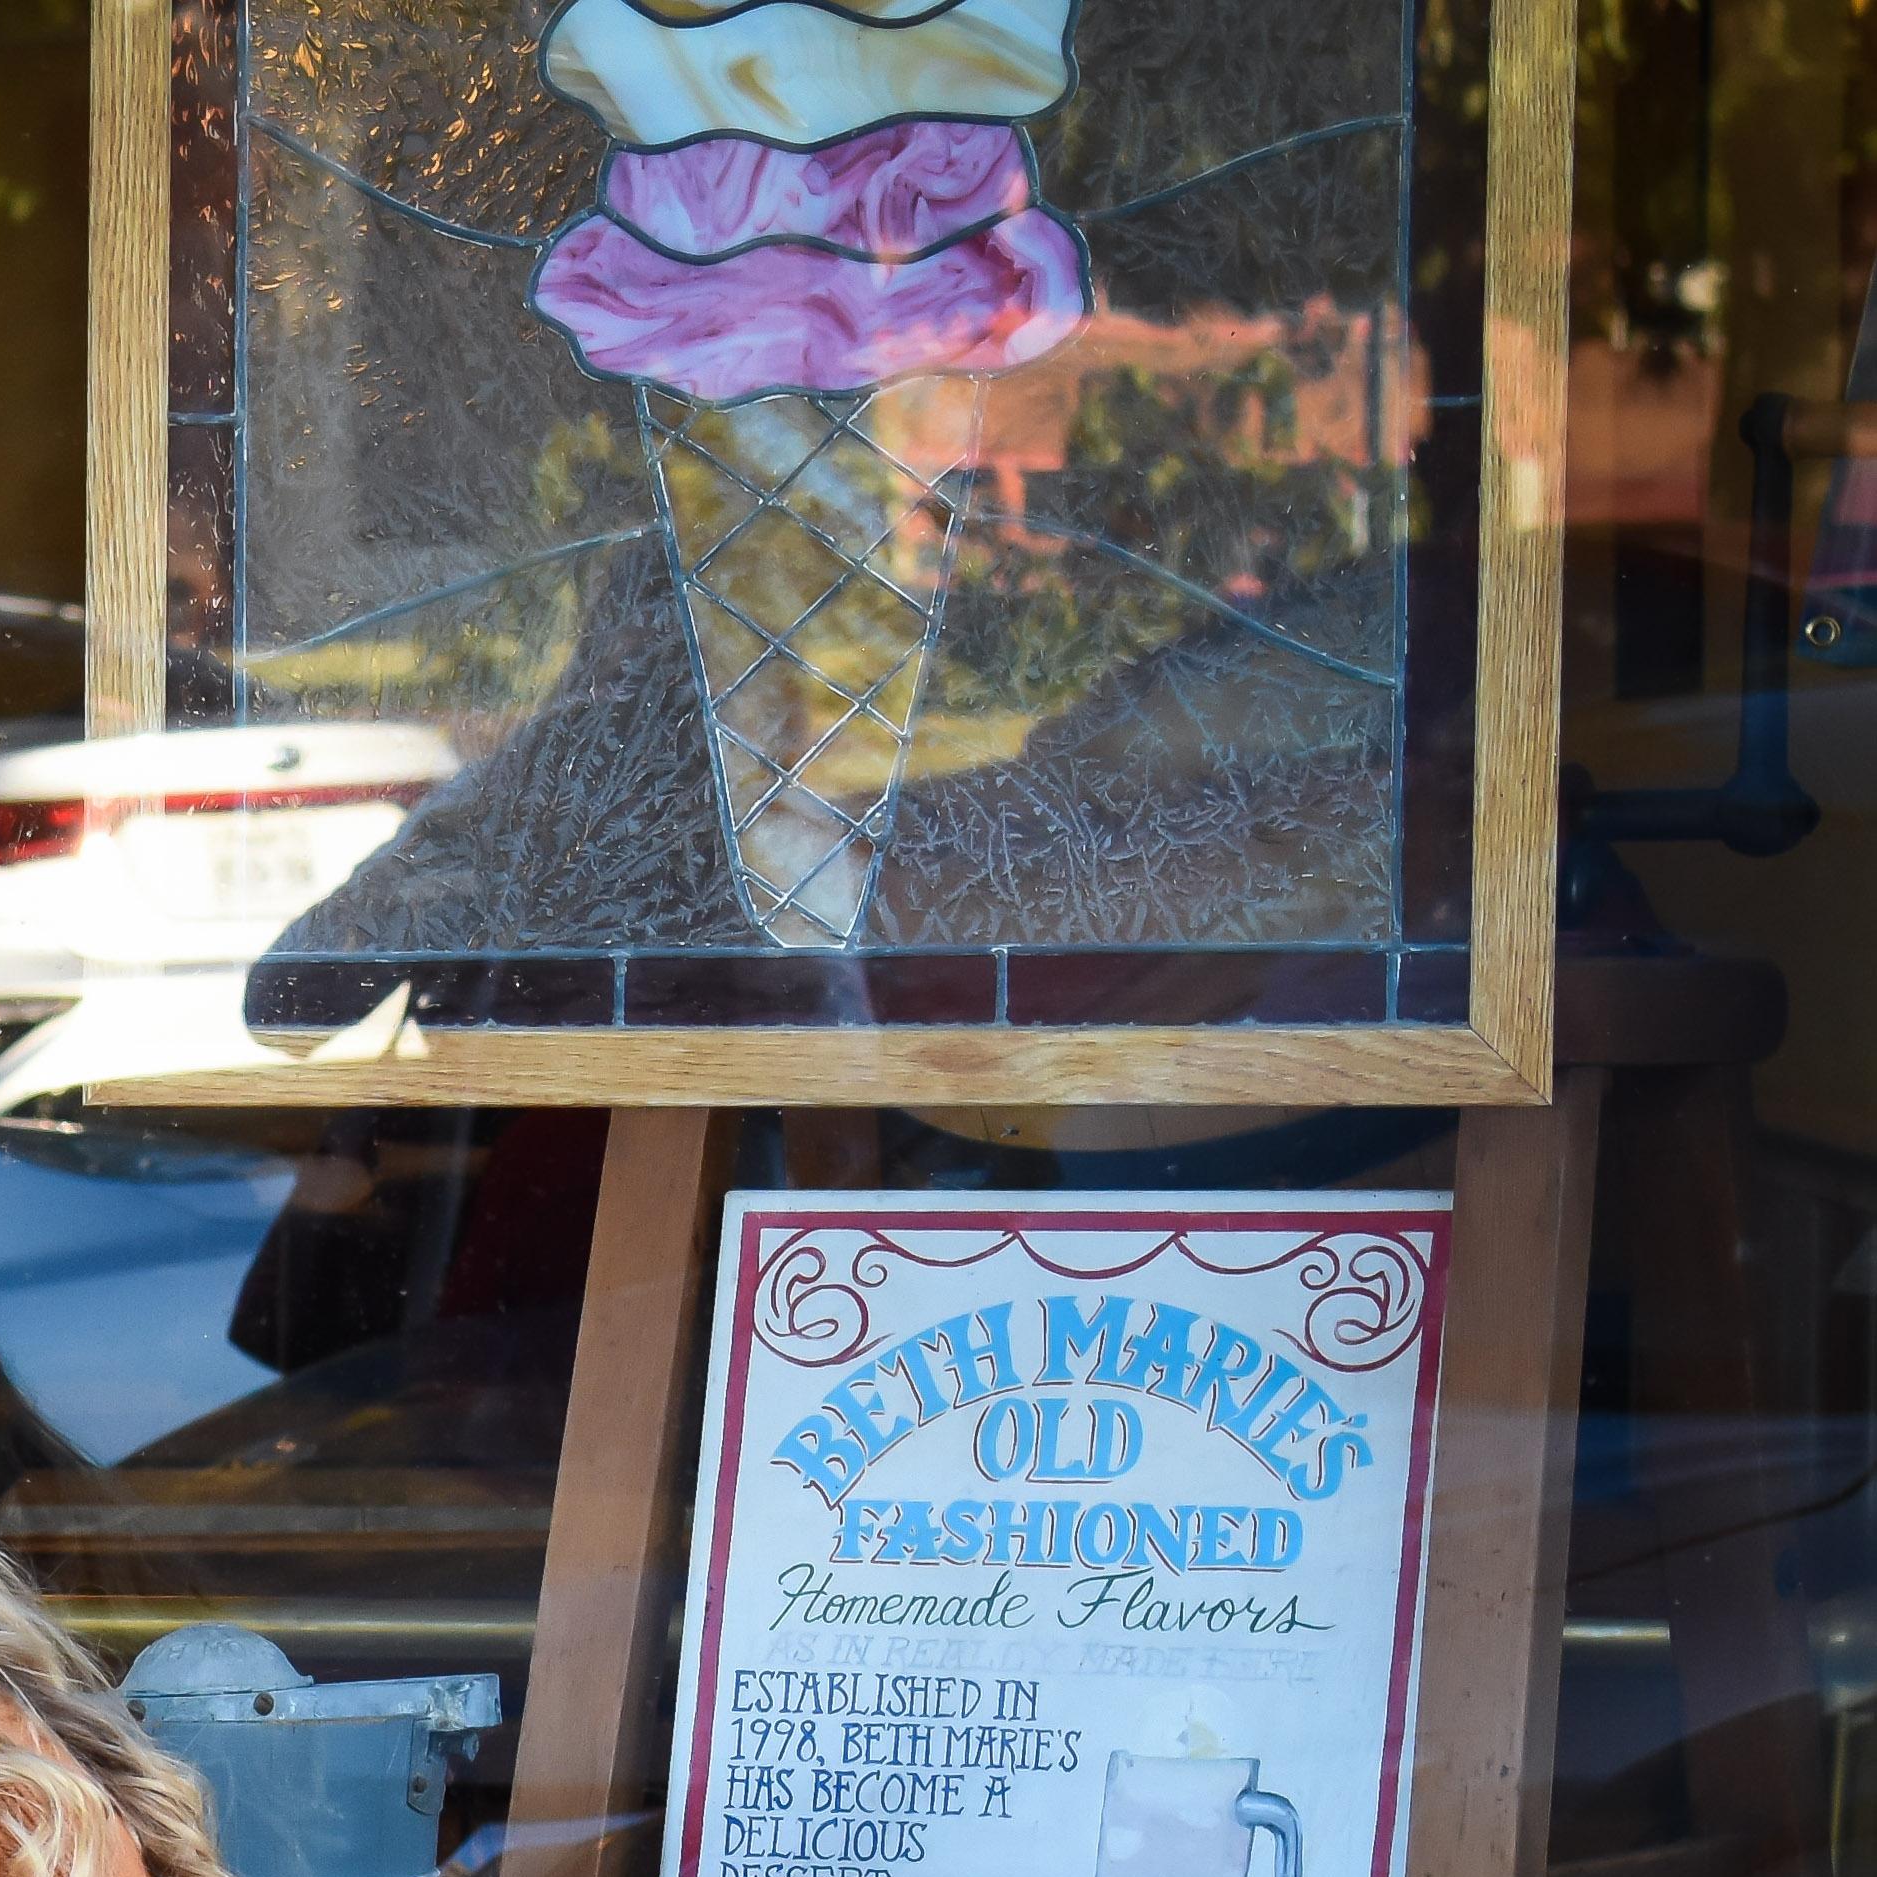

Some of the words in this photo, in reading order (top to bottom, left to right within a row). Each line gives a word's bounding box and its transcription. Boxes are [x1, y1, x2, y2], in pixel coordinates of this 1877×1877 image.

[770, 1299, 1025, 1511] BETH
[1031, 1295, 1375, 1501] MARIE'S
[973, 1398, 1144, 1484] OLD
[829, 1500, 1304, 1576] FASHIONED
[767, 1563, 1035, 1631] Homemade
[1057, 1569, 1336, 1634] Flavors
[731, 1670, 981, 1718] ESTABLISHED
[993, 1680, 1040, 1721] IN
[730, 1718, 824, 1766] 1998,
[841, 1722, 935, 1768] BETH
[940, 1725, 1081, 1775] MARIE'S
[724, 1765, 795, 1811] HAS
[812, 1768, 965, 1815] BECOME
[978, 1775, 1012, 1818] A
[724, 1814, 927, 1862] DELICIOUS
